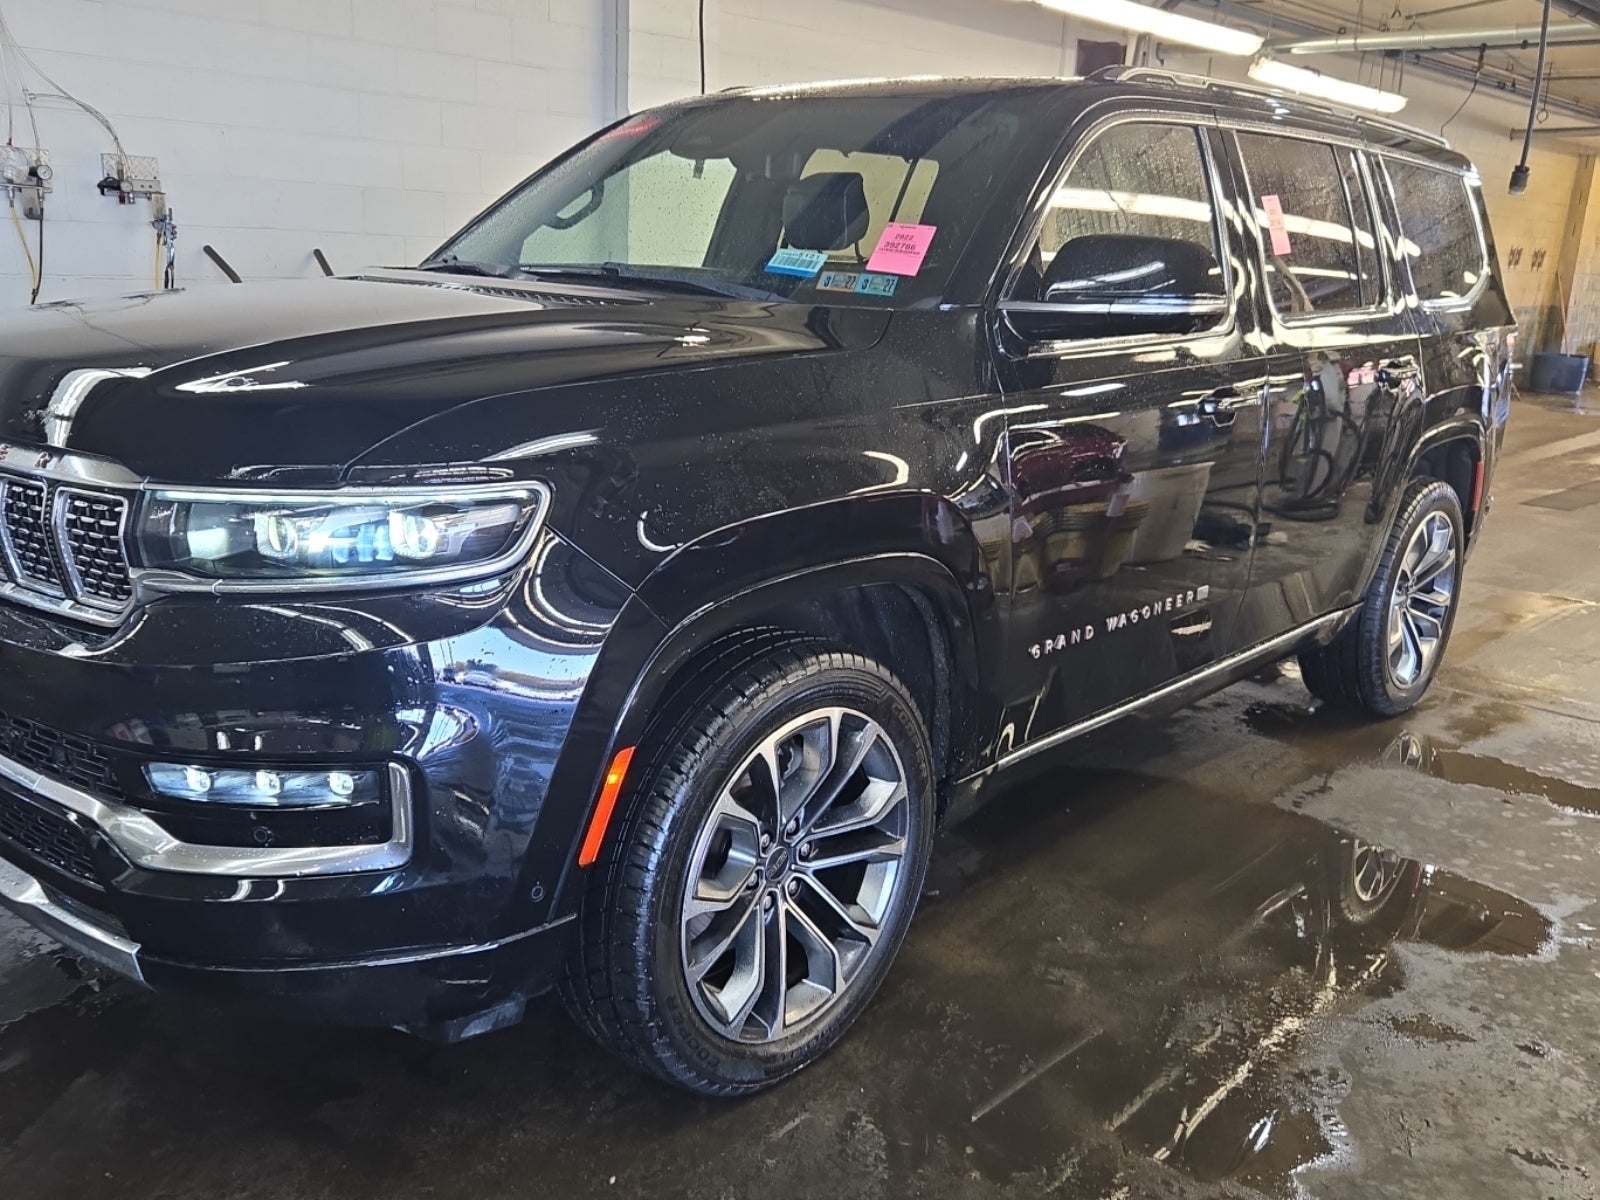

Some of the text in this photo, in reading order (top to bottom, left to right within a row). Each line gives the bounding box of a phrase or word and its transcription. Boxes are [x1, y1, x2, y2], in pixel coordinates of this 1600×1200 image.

[882, 278, 895, 292] 27
[1028, 590, 1194, 659] GRAND WAGONEER
[891, 702, 928, 778] COOPER
[666, 993, 720, 1067] COOPER
